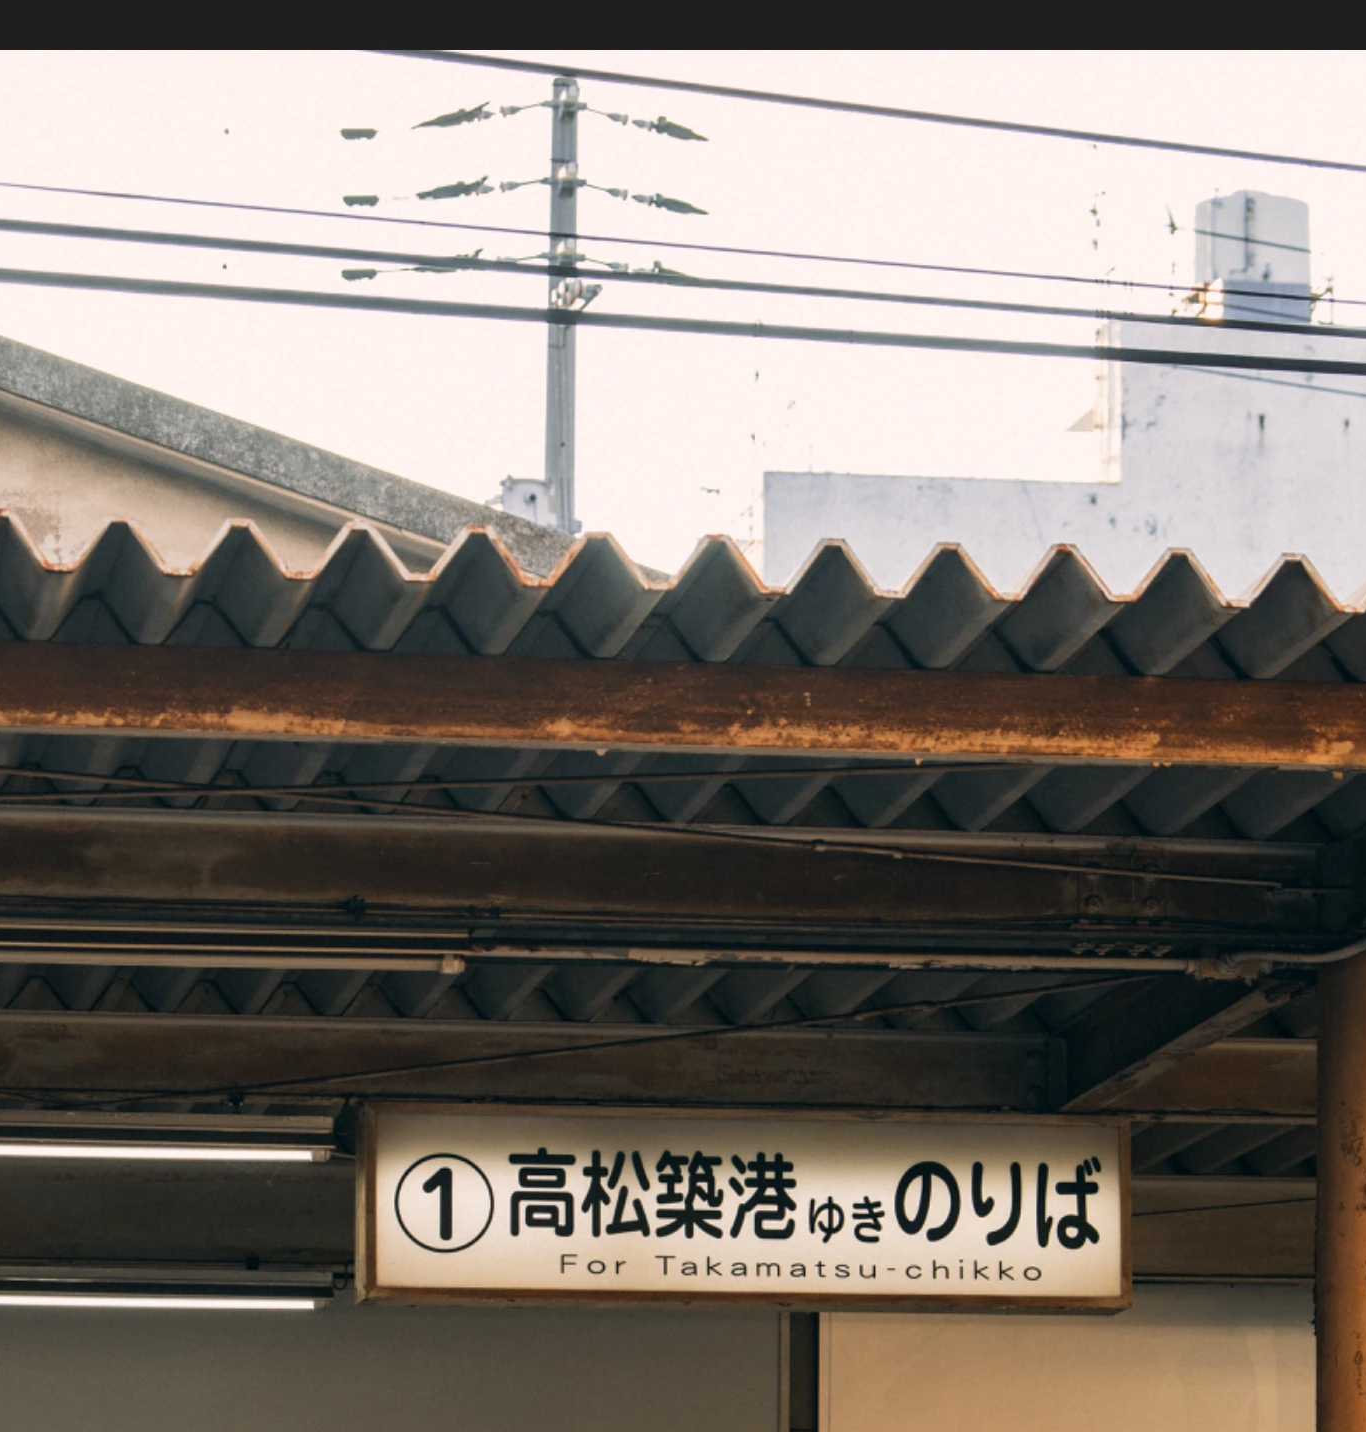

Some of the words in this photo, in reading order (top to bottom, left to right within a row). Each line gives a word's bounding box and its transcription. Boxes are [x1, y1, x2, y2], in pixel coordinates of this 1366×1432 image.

[508, 1147, 1102, 1251] 高松築港ゆきのりば
[559, 1253, 626, 1276] For
[655, 1255, 1044, 1282] Takamatsu-chikko
